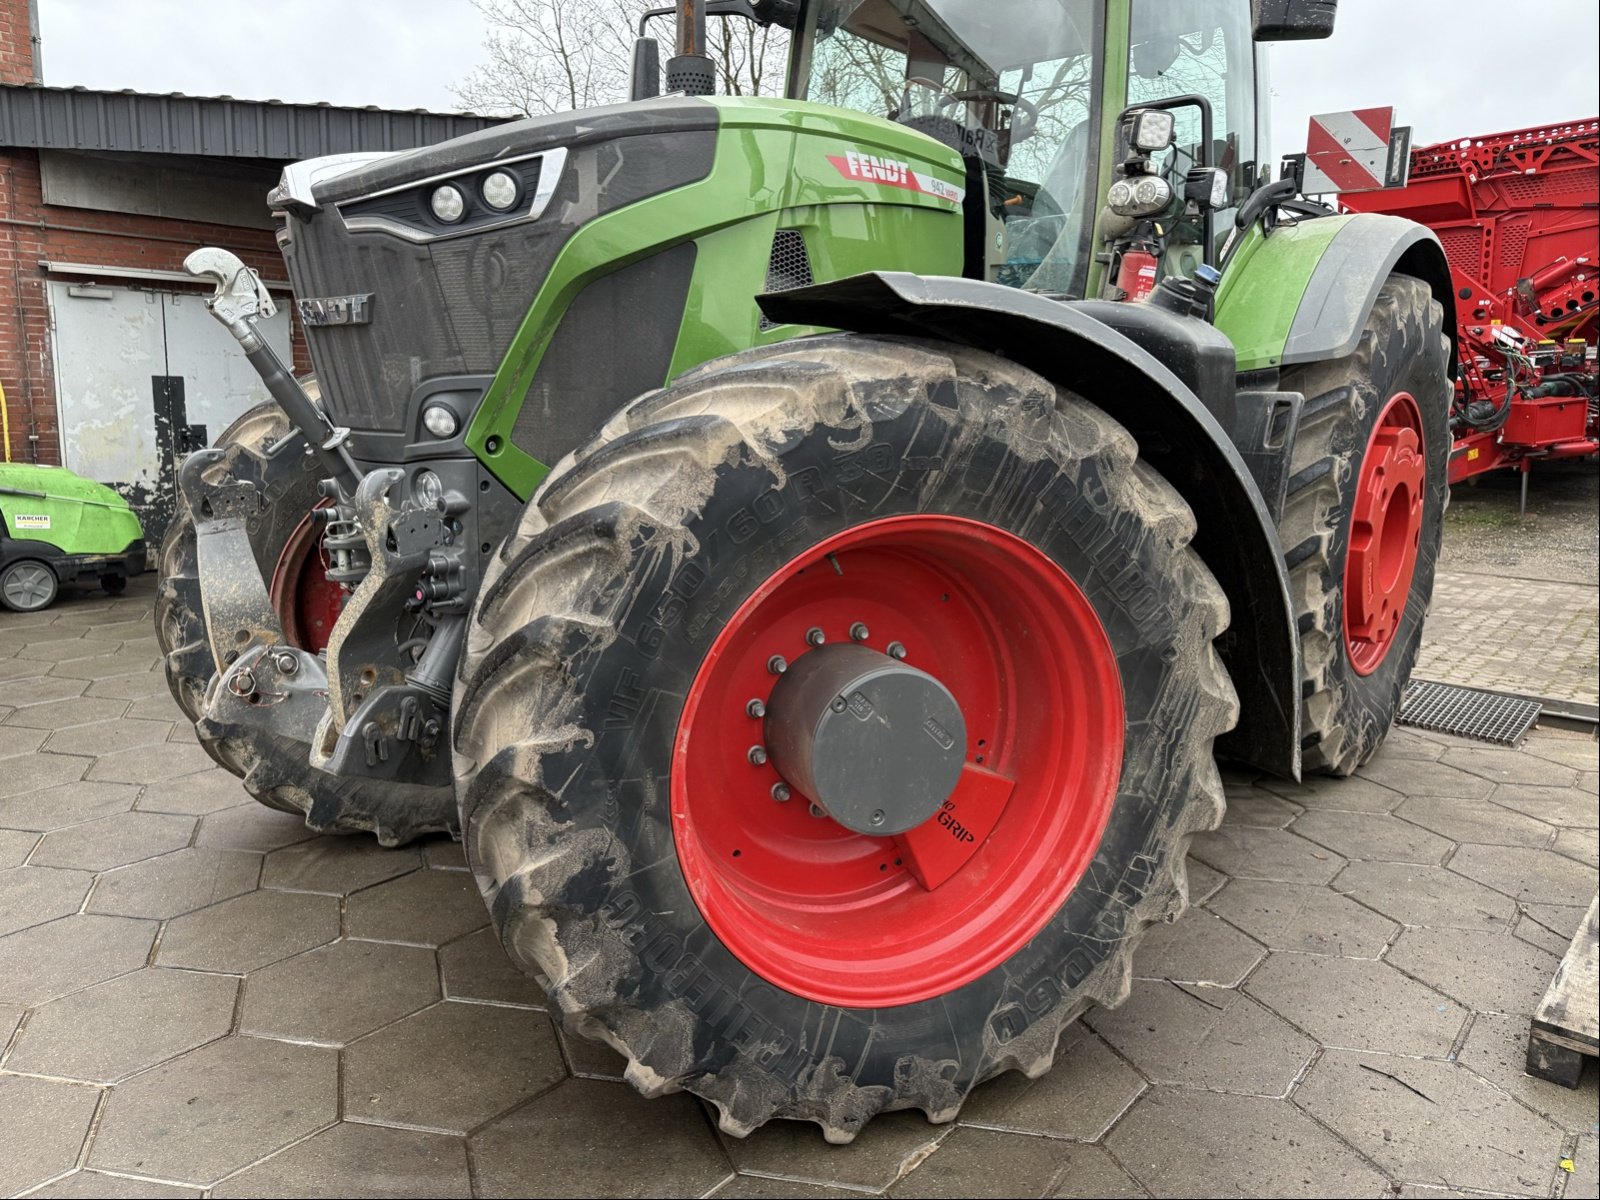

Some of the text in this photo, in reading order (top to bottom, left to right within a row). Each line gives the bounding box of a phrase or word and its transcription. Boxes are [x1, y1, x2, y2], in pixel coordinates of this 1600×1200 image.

[845, 150, 958, 200] FENDT 942 VARIO
[603, 666, 642, 736] VF
[788, 465, 827, 499] R
[937, 811, 974, 842] GRIP
